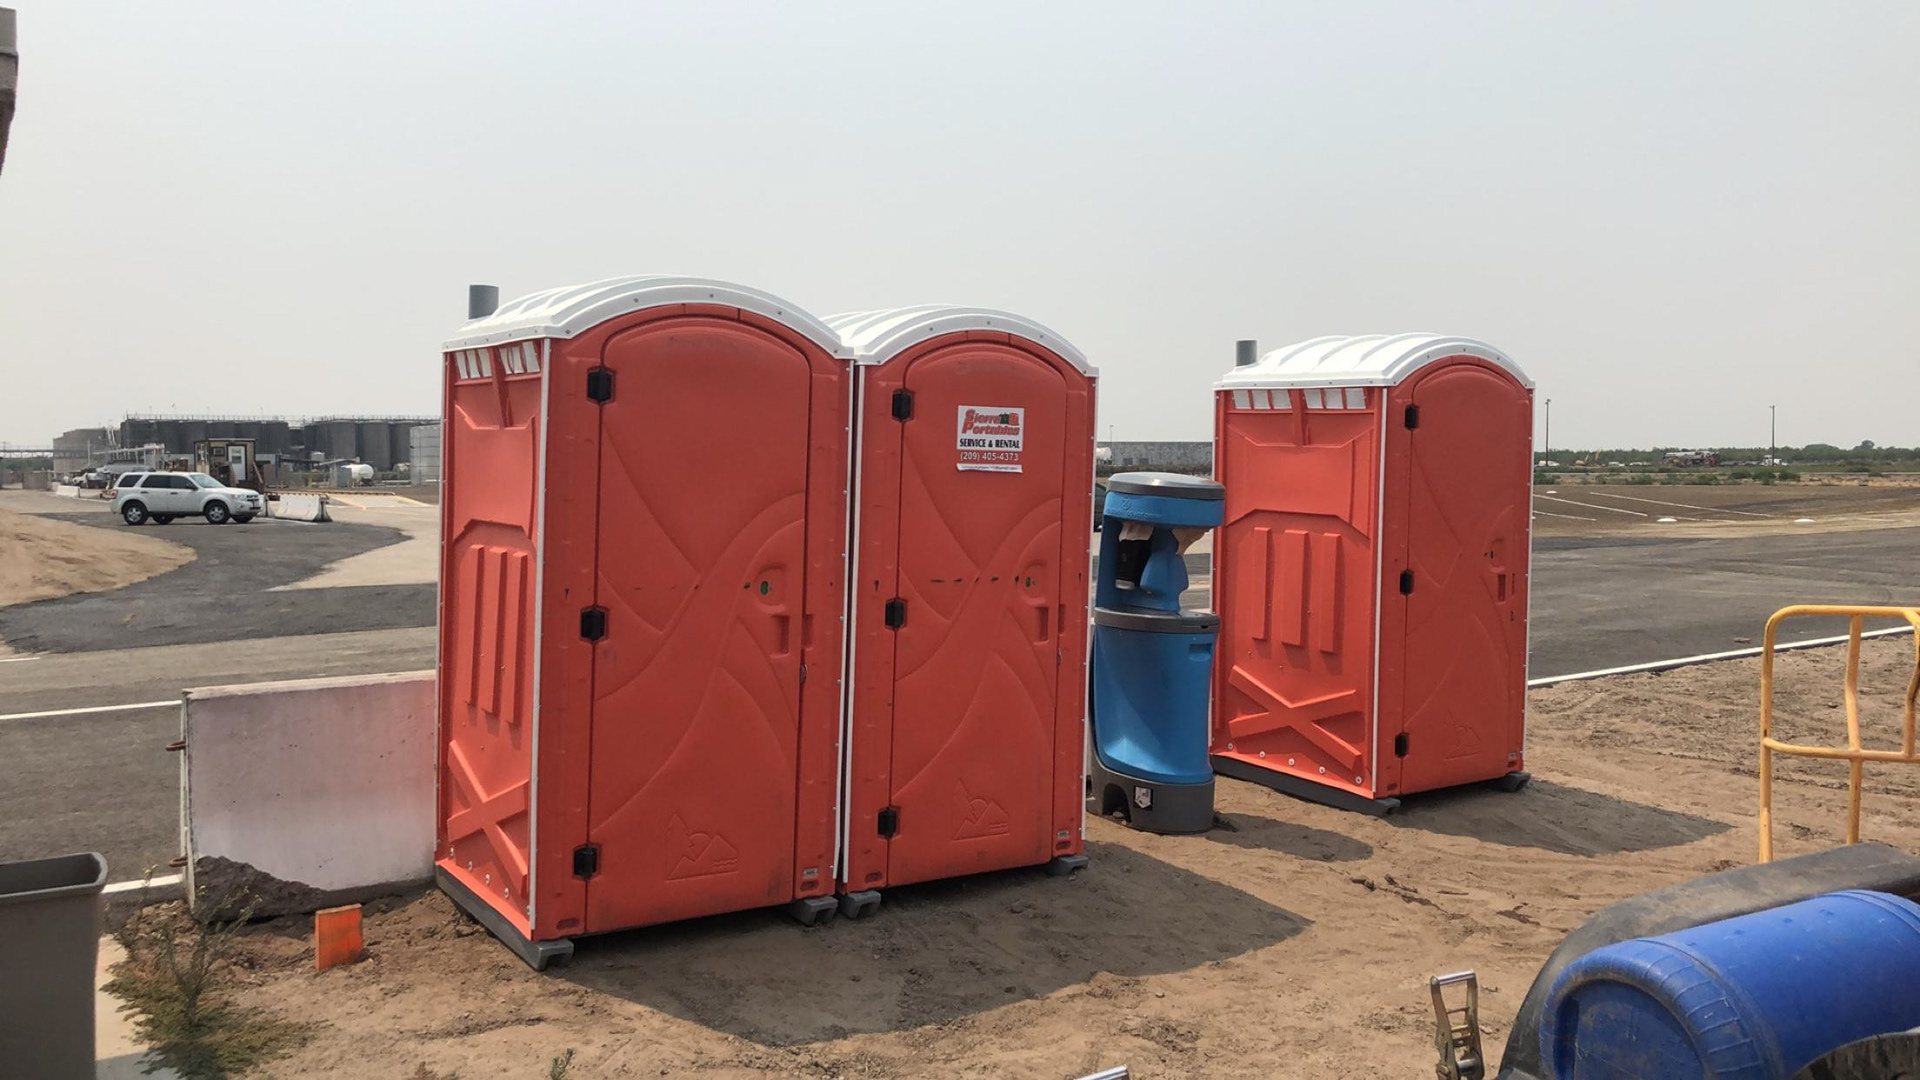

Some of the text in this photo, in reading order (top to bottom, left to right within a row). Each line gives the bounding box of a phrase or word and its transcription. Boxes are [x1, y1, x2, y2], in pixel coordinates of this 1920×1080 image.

[960, 438, 1020, 449] SERVICE & RENTAL
[960, 452, 1019, 462] (209) 405-4373
